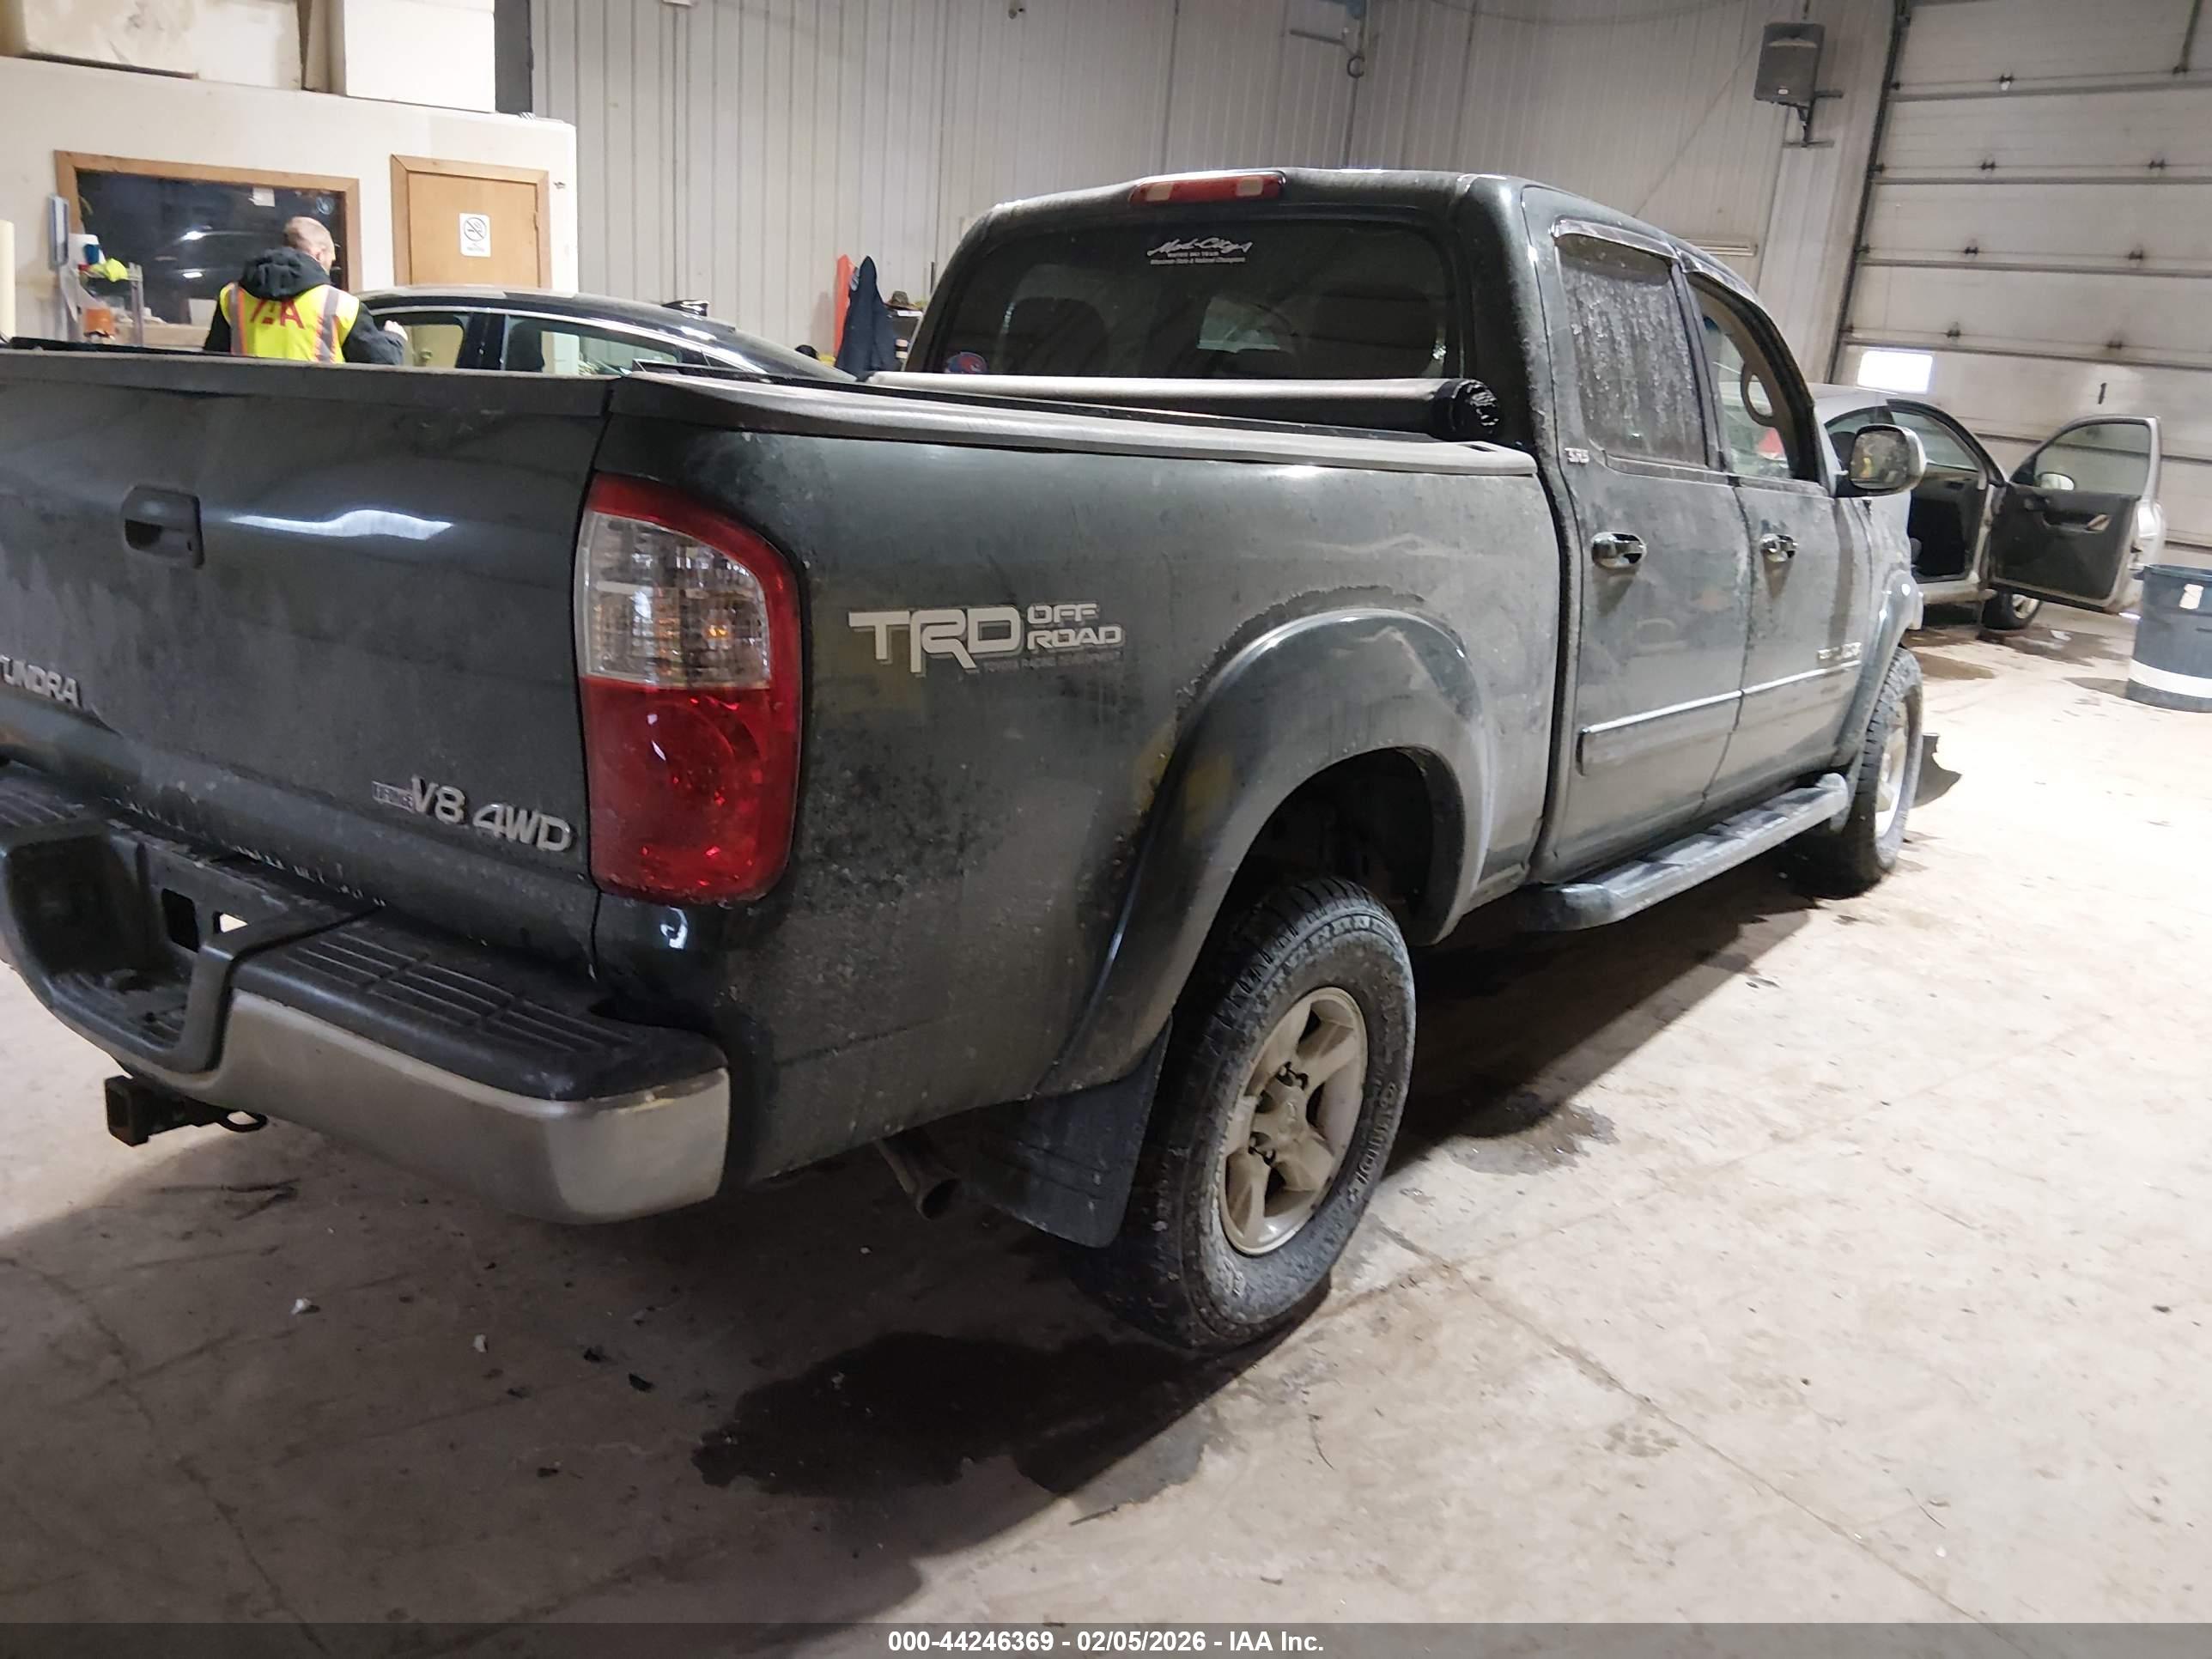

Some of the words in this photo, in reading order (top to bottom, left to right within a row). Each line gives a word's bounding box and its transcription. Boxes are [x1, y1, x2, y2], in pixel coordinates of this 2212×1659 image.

[1027, 603, 1098, 624] OFF
[848, 606, 1022, 672] TRD
[1027, 625, 1122, 650] ROAD
[411, 775, 466, 824] V8
[472, 803, 574, 852] 4WD
